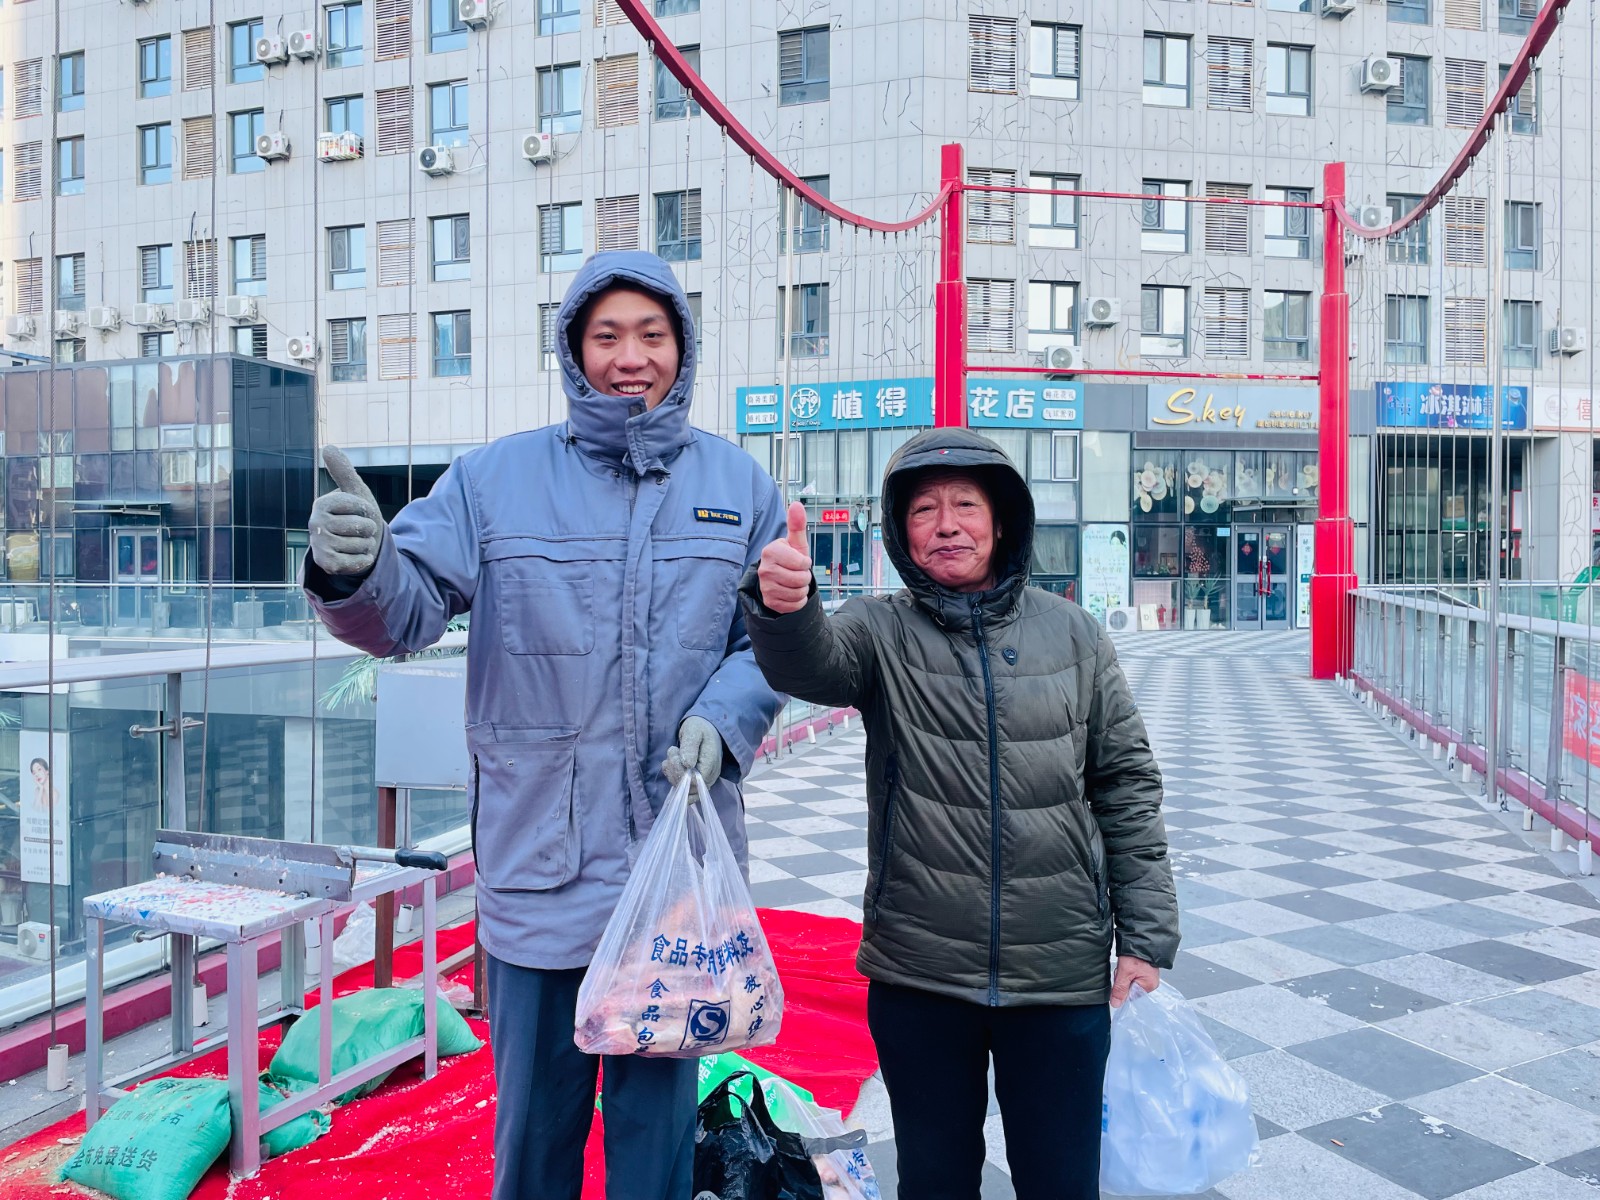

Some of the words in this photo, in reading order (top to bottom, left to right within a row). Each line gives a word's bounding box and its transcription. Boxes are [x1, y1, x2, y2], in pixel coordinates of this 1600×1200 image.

[832, 386, 1036, 421] 植得花店
[71, 1145, 158, 1172] 全市免费送货
